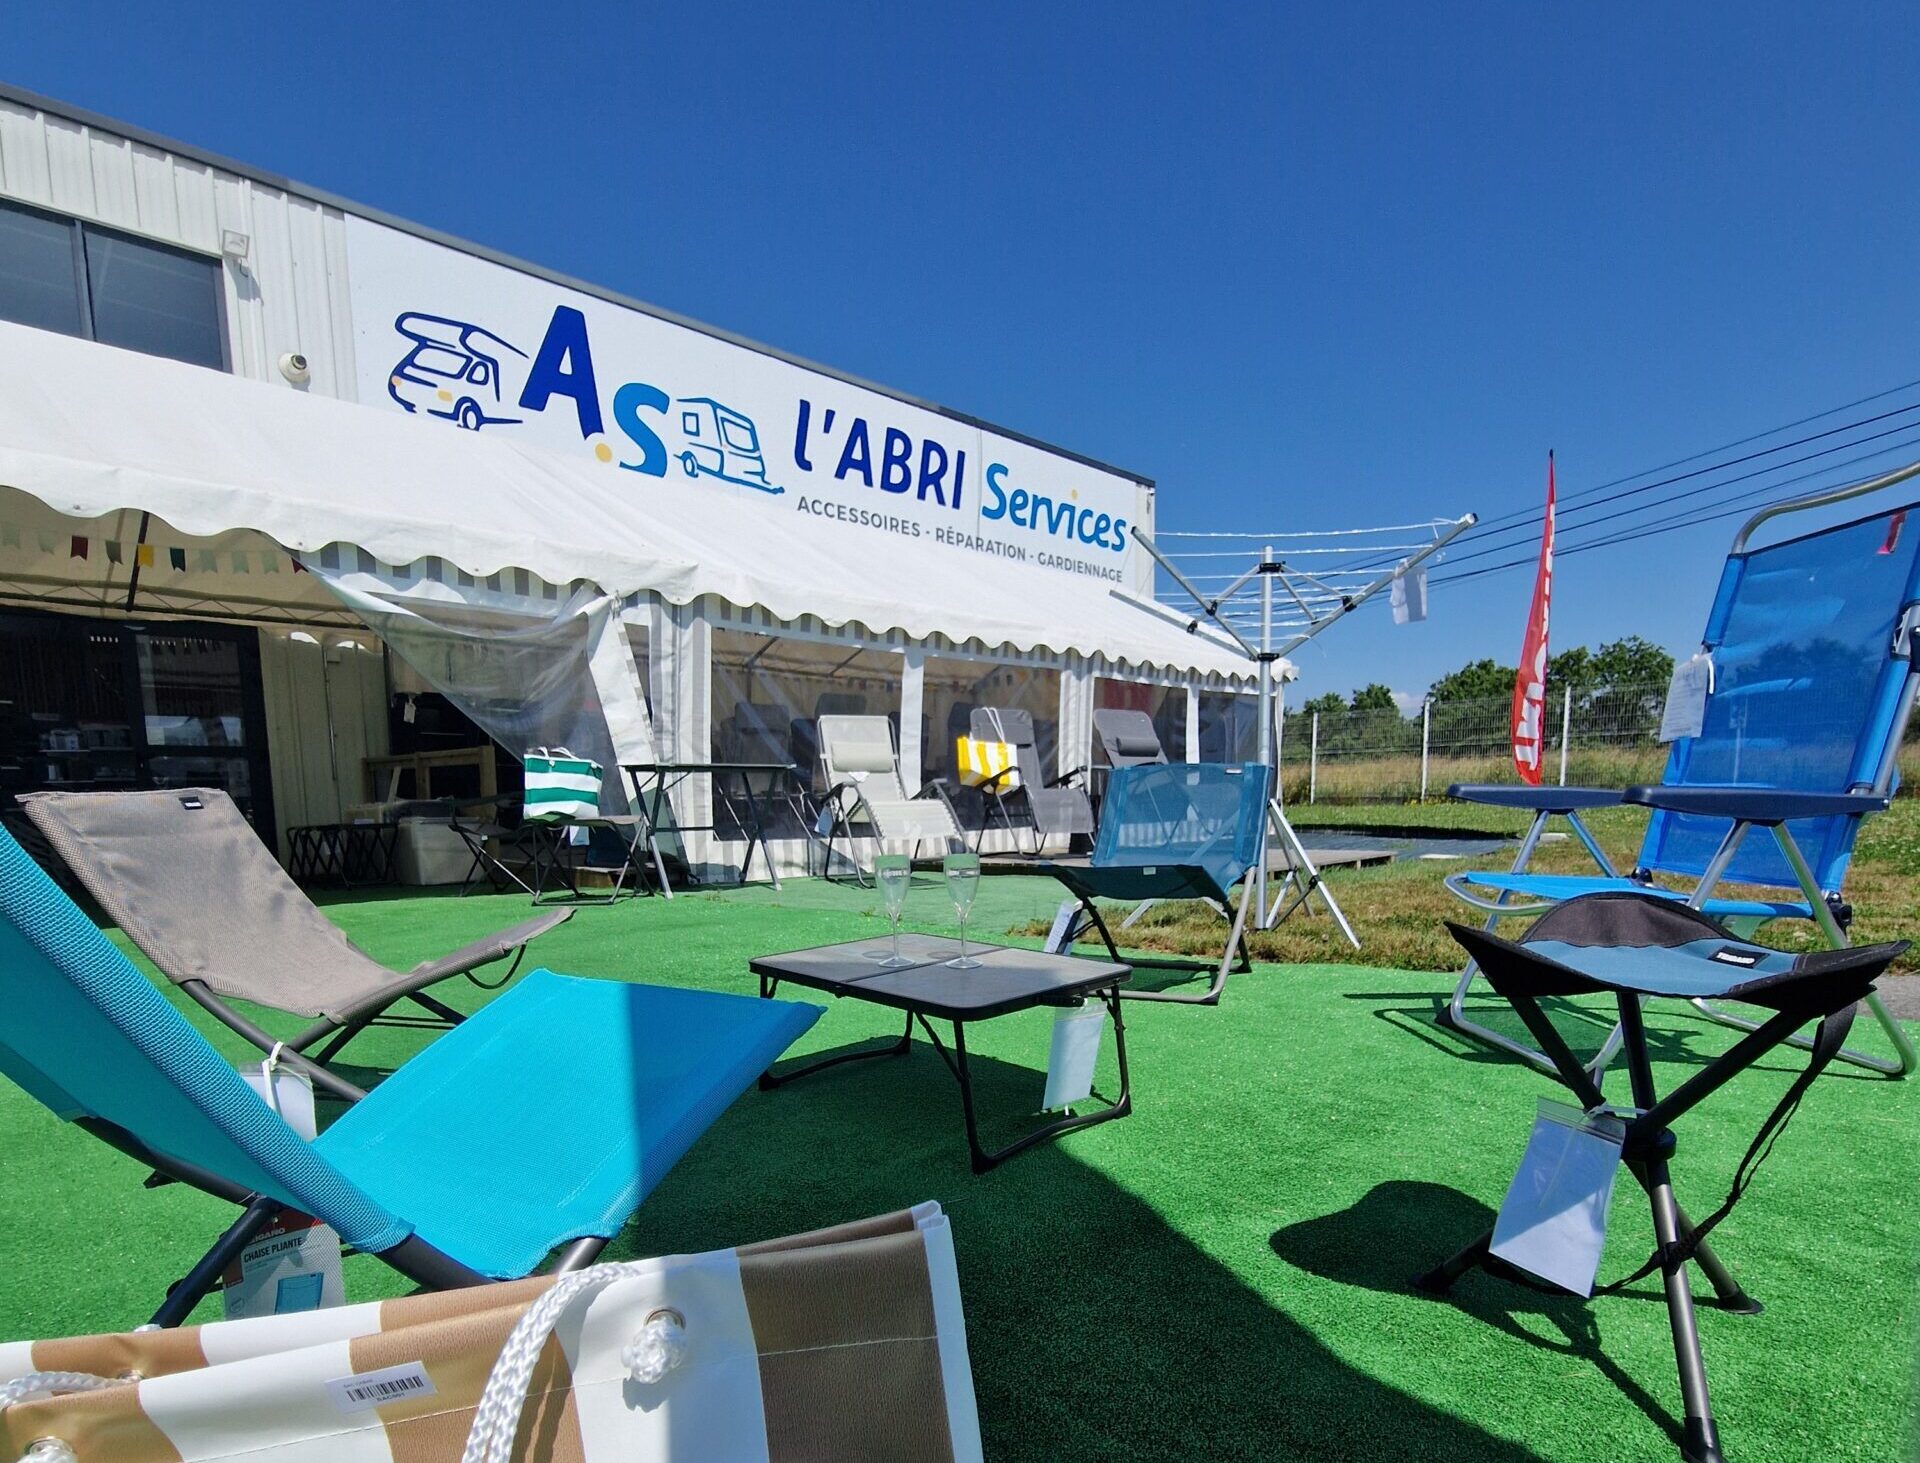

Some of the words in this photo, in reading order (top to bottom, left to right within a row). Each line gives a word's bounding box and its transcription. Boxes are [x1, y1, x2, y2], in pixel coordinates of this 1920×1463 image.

[797, 496, 920, 537] ACCESSOIRES
[936, 526, 1026, 561] RÉPARATION
[1037, 552, 1123, 583] GARDIENNAGE
[981, 463, 1127, 552] Services
[243, 1247, 271, 1263] CHAISE
[271, 1237, 303, 1255] PLIANTE
